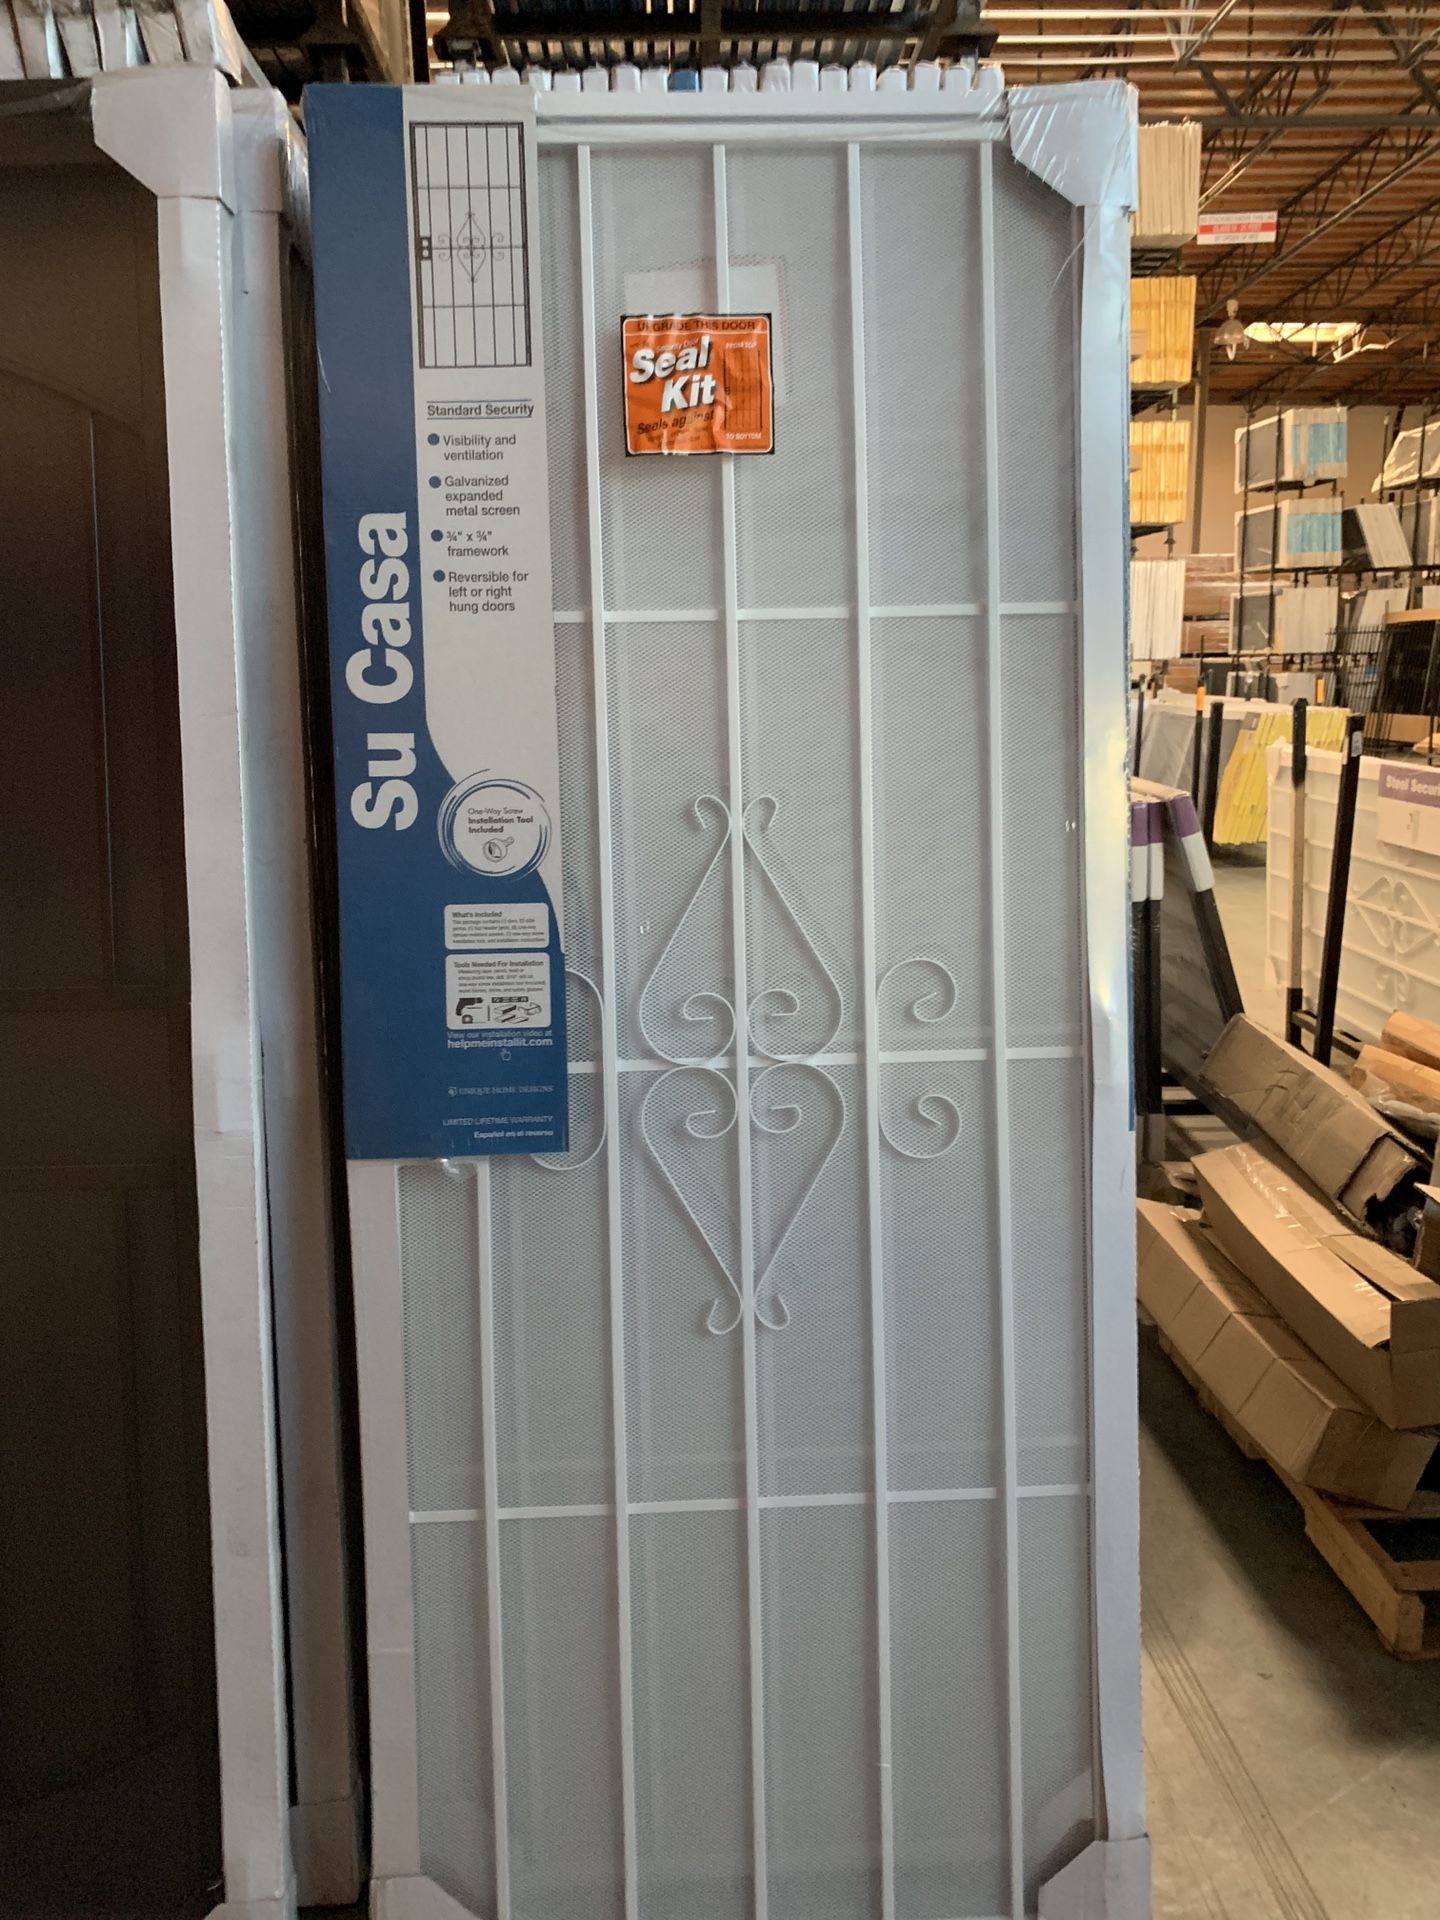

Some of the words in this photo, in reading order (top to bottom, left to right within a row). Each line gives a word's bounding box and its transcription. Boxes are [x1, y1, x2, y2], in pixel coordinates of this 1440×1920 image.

[722, 320, 755, 330] DOOR
[630, 335, 711, 383] Seal
[661, 374, 716, 412] Kit
[427, 404, 482, 416] Standard
[485, 403, 534, 417] Security
[637, 418, 668, 435] Seals
[443, 435, 491, 448] Visibility
[494, 434, 516, 446] and
[444, 450, 504, 461] ventilation
[444, 475, 509, 487] Galvanized
[445, 490, 503, 504] expanded
[446, 505, 478, 516] metal
[482, 506, 520, 516] screen
[466, 533, 474, 542] x
[447, 545, 509, 556] framework
[448, 571, 509, 583] Reversible
[512, 571, 529, 582] for
[449, 586, 467, 597] left
[470, 588, 483, 597] or
[486, 585, 512, 600] right
[345, 511, 414, 704] Casa
[449, 602, 478, 614] hung
[482, 600, 515, 612] doors
[350, 733, 419, 831] Su
[468, 808, 501, 816] One-Way
[503, 807, 523, 815] Screw
[468, 816, 514, 824] Installation
[481, 1030, 521, 1038] installation
[447, 1038, 553, 1050] helpmeinstallit.com
[442, 1118, 473, 1126] LIMITED
[474, 1117, 509, 1125] LIFETIME
[510, 1115, 553, 1123] WARRANTY
